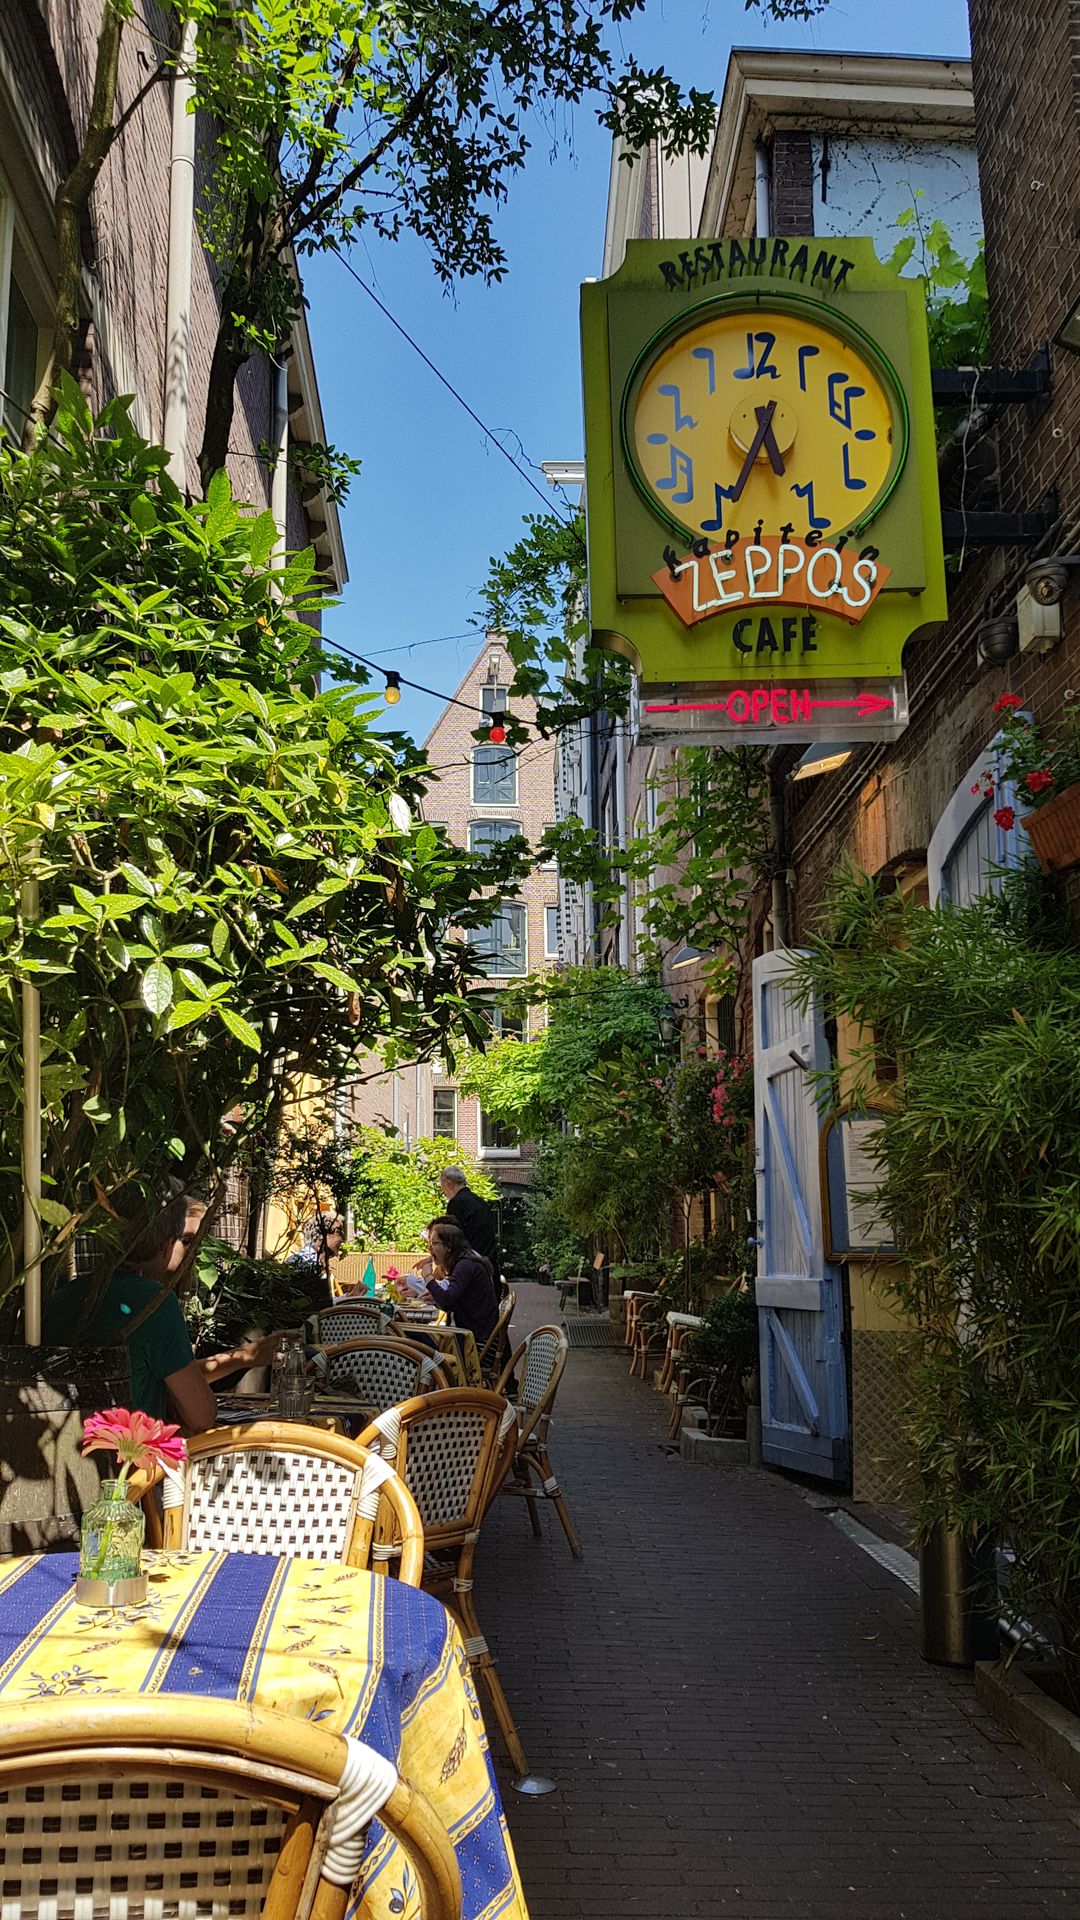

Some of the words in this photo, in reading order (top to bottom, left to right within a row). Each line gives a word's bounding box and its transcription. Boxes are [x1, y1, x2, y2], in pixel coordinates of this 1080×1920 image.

[659, 238, 855, 288] RESTAURANT
[674, 543, 877, 612] ZEPPOS
[727, 689, 811, 723] OPEN
